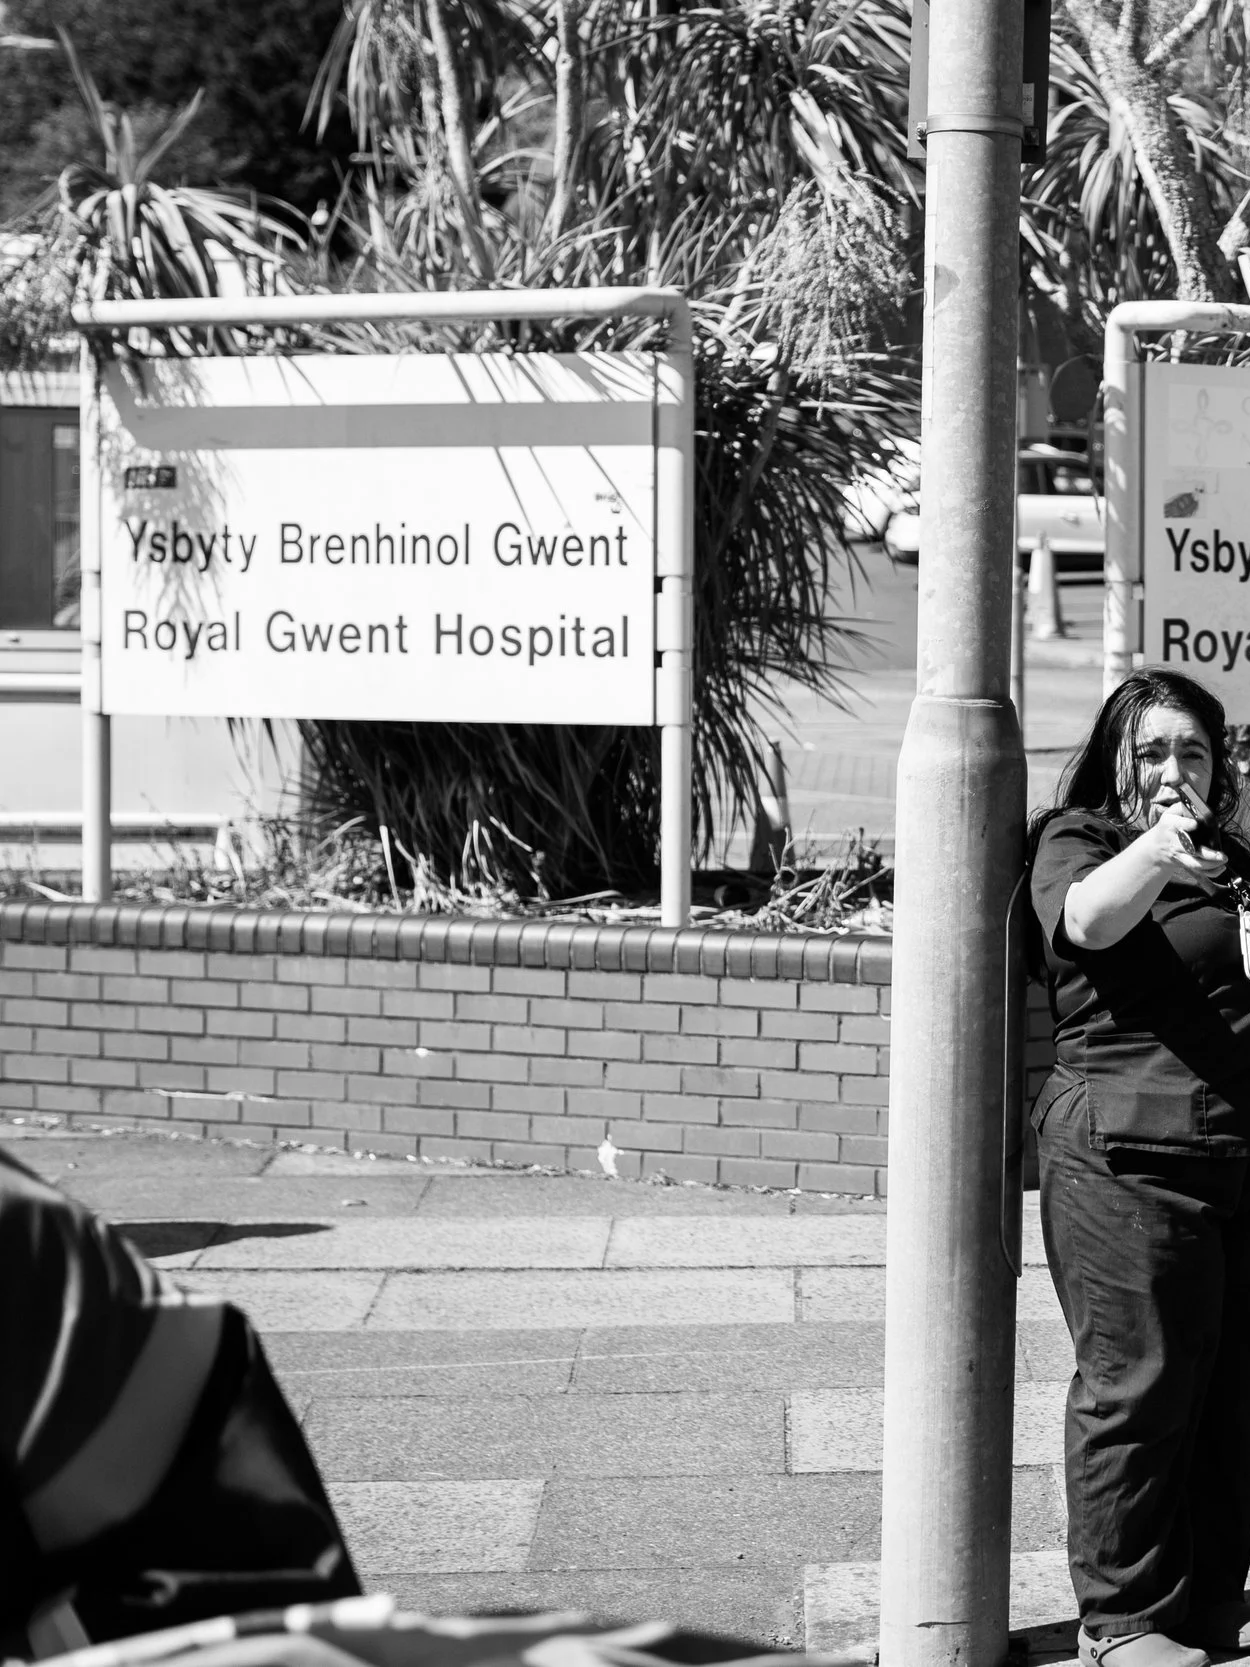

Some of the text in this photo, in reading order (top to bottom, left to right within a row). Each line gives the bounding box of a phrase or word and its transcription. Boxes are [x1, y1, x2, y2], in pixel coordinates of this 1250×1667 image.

[125, 519, 628, 574] Ysbyty Brenhinol Gwent
[124, 610, 629, 666] Royal Gwent Hospital
